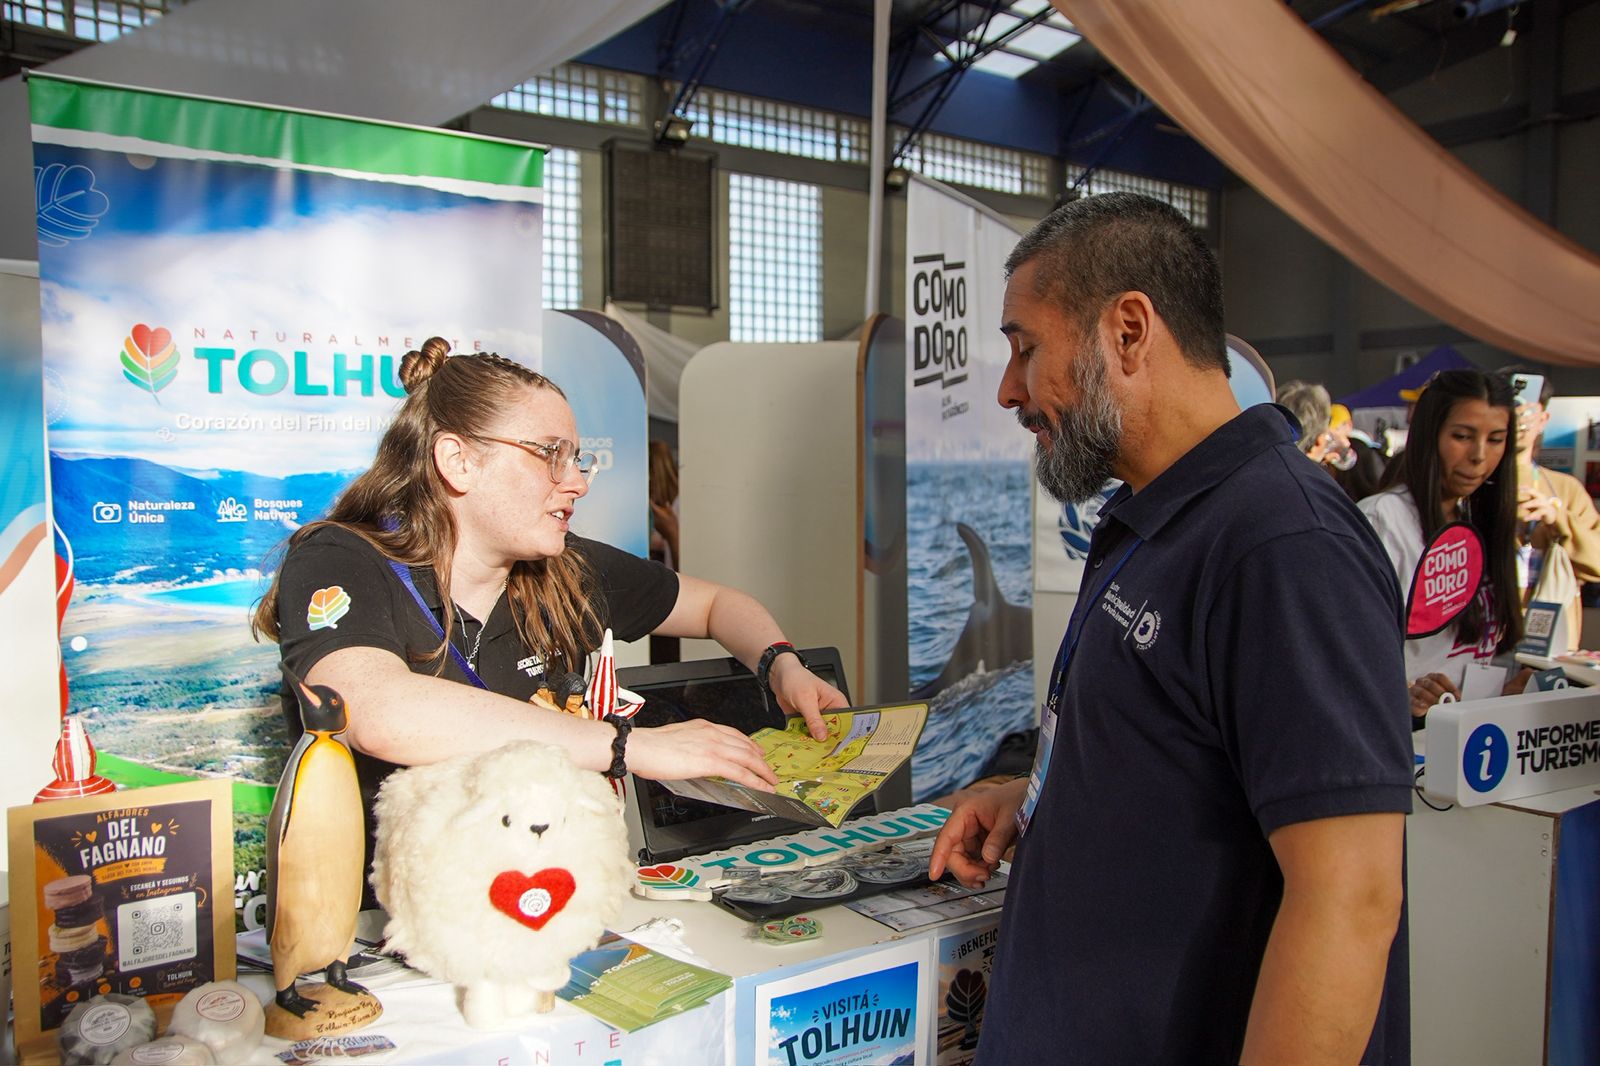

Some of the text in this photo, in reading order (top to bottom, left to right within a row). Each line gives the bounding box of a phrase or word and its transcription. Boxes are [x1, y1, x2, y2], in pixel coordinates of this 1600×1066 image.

[913, 268, 967, 321] COMO
[193, 327, 482, 351] NATURALMETE
[913, 321, 968, 373] DORO
[193, 346, 408, 399] TOLHU
[175, 411, 265, 432] Corazón
[271, 412, 302, 431] del
[307, 415, 337, 431] Fin
[342, 415, 371, 432] del
[128, 500, 195, 511] Naturaleza
[128, 510, 165, 523] Única
[254, 498, 303, 509] Bosques
[254, 509, 298, 520] Nativos
[1424, 547, 1468, 577] COMO
[1424, 568, 1469, 599] DORO
[525, 664, 544, 677] TURIS
[1516, 741, 1600, 775] TURISM
[96, 808, 149, 824] ALFAJORES
[107, 818, 140, 840] DEL
[80, 836, 166, 869] FAGNANO
[701, 807, 951, 868] TOLHUIN
[957, 928, 999, 959] ¡BENEFIC
[821, 989, 870, 1020] VISITÁ
[778, 1007, 912, 1066] TOLHUIN
